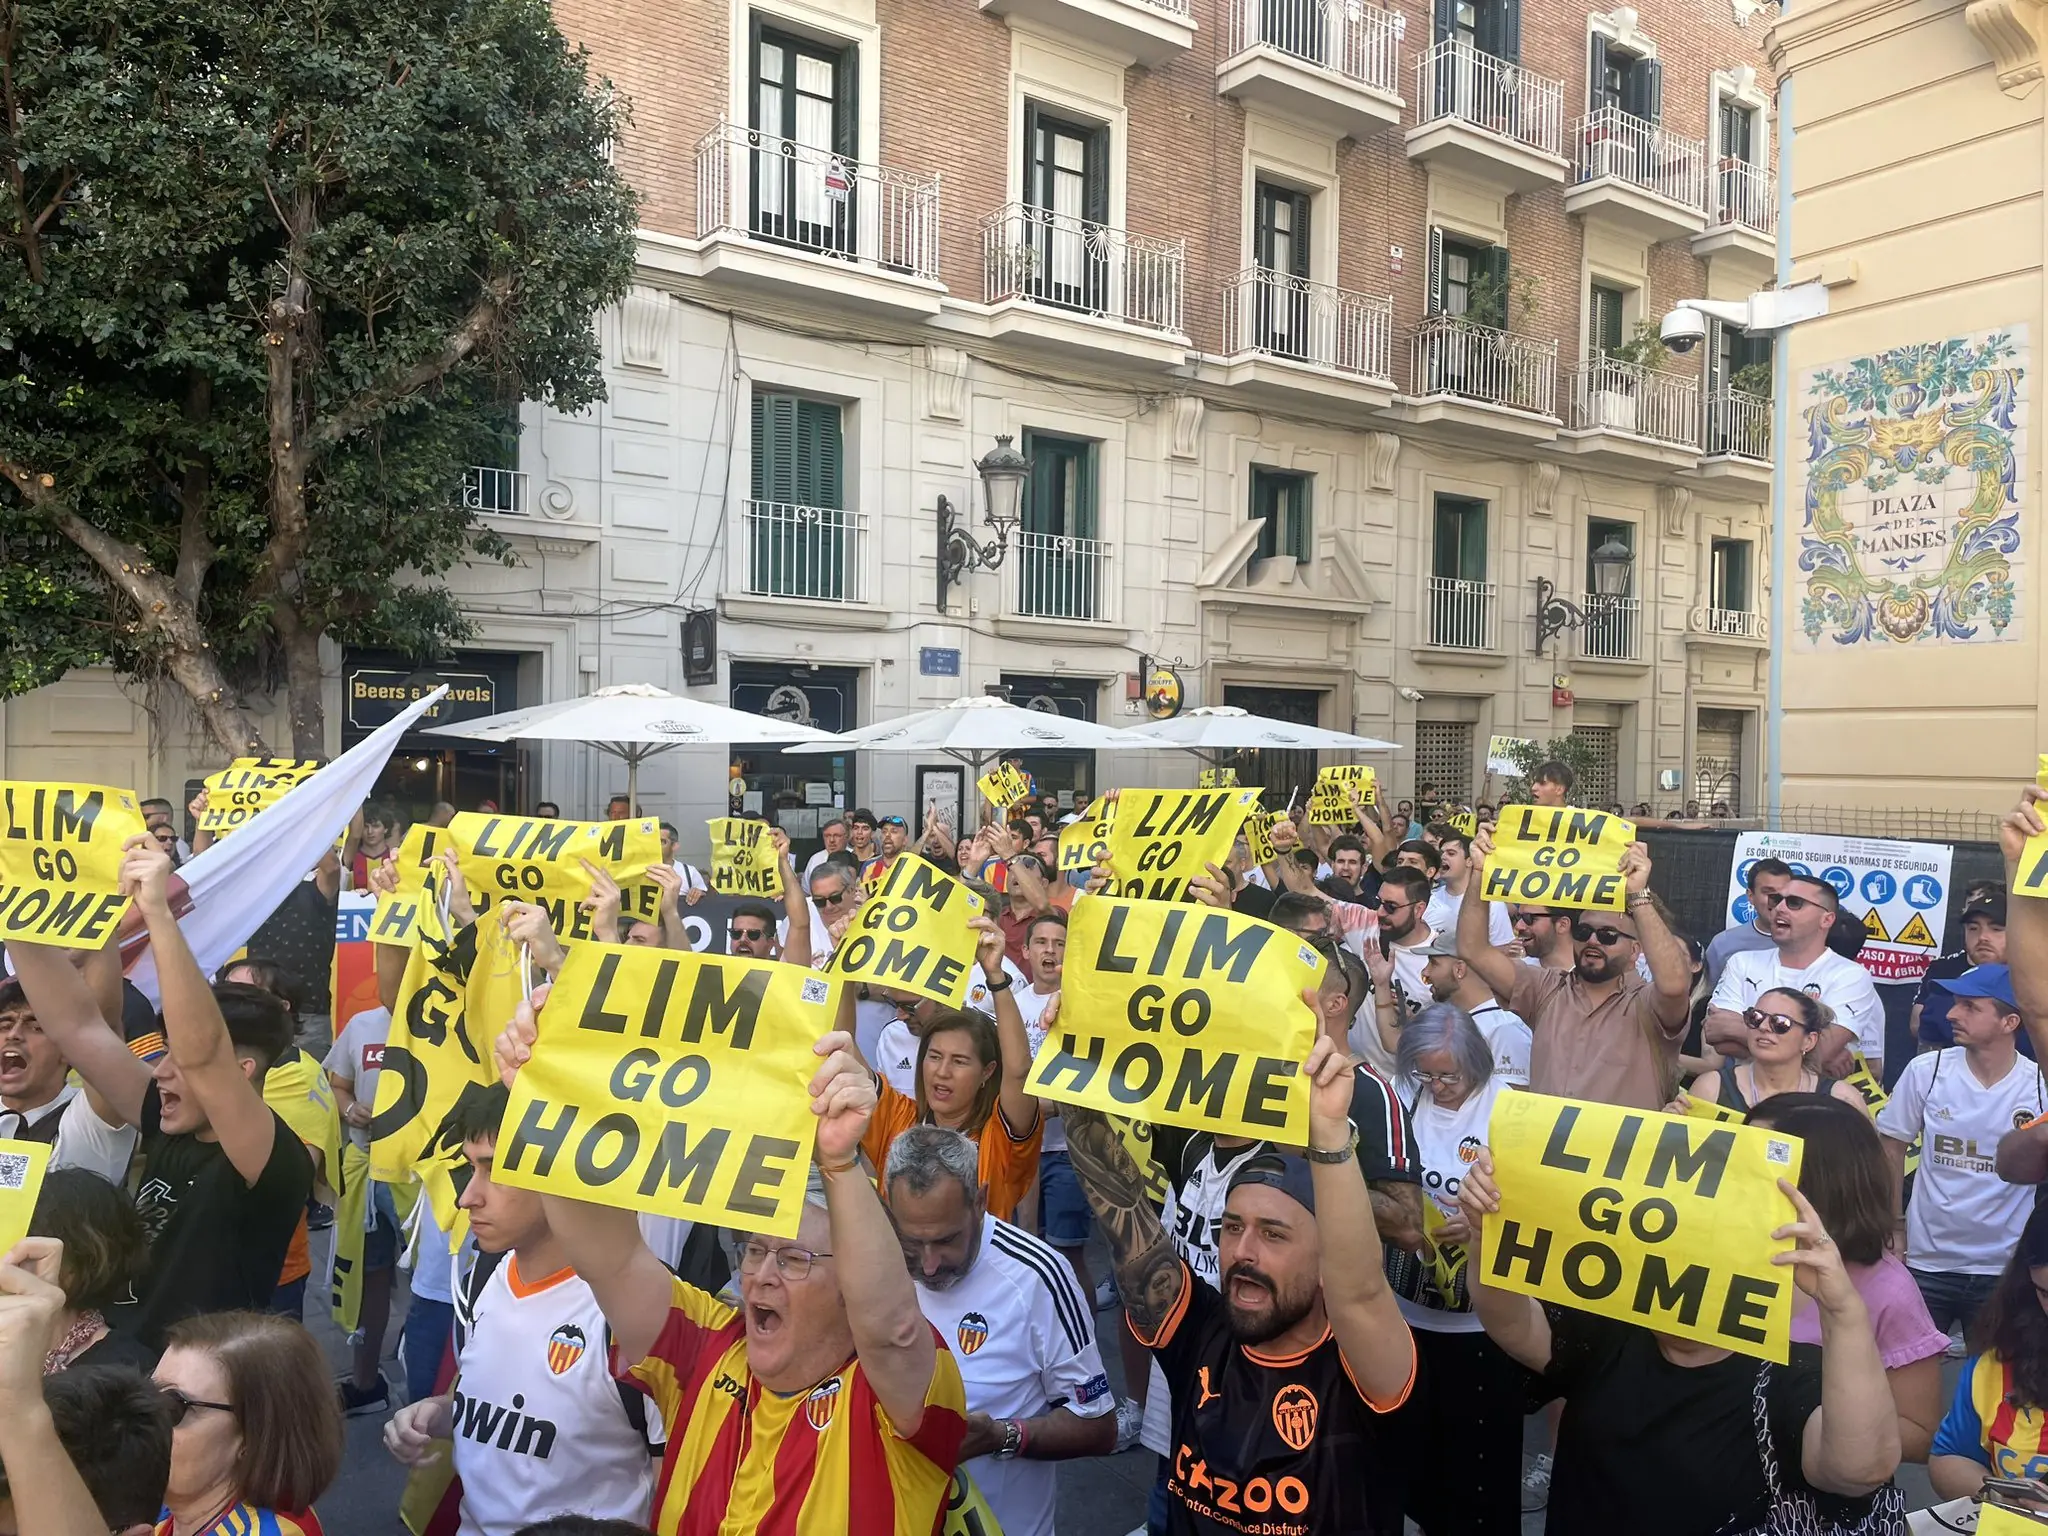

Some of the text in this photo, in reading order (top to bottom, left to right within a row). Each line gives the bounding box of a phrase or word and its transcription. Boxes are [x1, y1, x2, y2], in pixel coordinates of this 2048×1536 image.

[1872, 494, 1936, 516] PLAZA
[1894, 517, 1914, 530] DE
[1861, 530, 1947, 554] MANISES
[354, 682, 490, 701] Beers & Tavels
[421, 705, 439, 717] ar
[1330, 767, 1363, 780] LIM
[232, 791, 261, 805] GO
[1314, 784, 1340, 796] LIM
[1324, 798, 1338, 807] GO
[6, 788, 104, 842] LIM
[204, 807, 262, 827] HO
[1132, 793, 1232, 837] LIM
[1311, 808, 1353, 822] HOME
[1452, 815, 1470, 826] IM
[1517, 809, 1608, 845] LIM
[472, 818, 578, 862] LIM
[33, 847, 77, 882] GO
[1137, 840, 1183, 872] GO
[1533, 847, 1581, 868] GO
[1746, 848, 1938, 873] ES OBLIGATORIO SEGUIR LAS NORMAS DE SEGURIDAD
[495, 864, 544, 890] GO
[716, 867, 775, 892] HOME
[872, 857, 955, 912] IM
[1485, 868, 1622, 905] HOME
[862, 901, 918, 932] GO
[1095, 905, 1274, 983] LIM
[1857, 949, 1885, 961] PASO
[1888, 955, 1896, 963] A
[1878, 965, 1892, 976] LA
[578, 953, 773, 1050] LIM
[1127, 984, 1211, 1037] GO
[609, 1047, 712, 1108] GO
[1036, 1033, 1299, 1128] HOME
[502, 1099, 801, 1218] HOME
[1540, 1105, 1737, 1199] LIM
[1934, 1134, 1994, 1161] BL
[1934, 1153, 1994, 1173] smartph
[1579, 1186, 1678, 1244] GO
[1194, 1252, 1218, 1274] LIK
[1492, 1219, 1780, 1345] HOME
